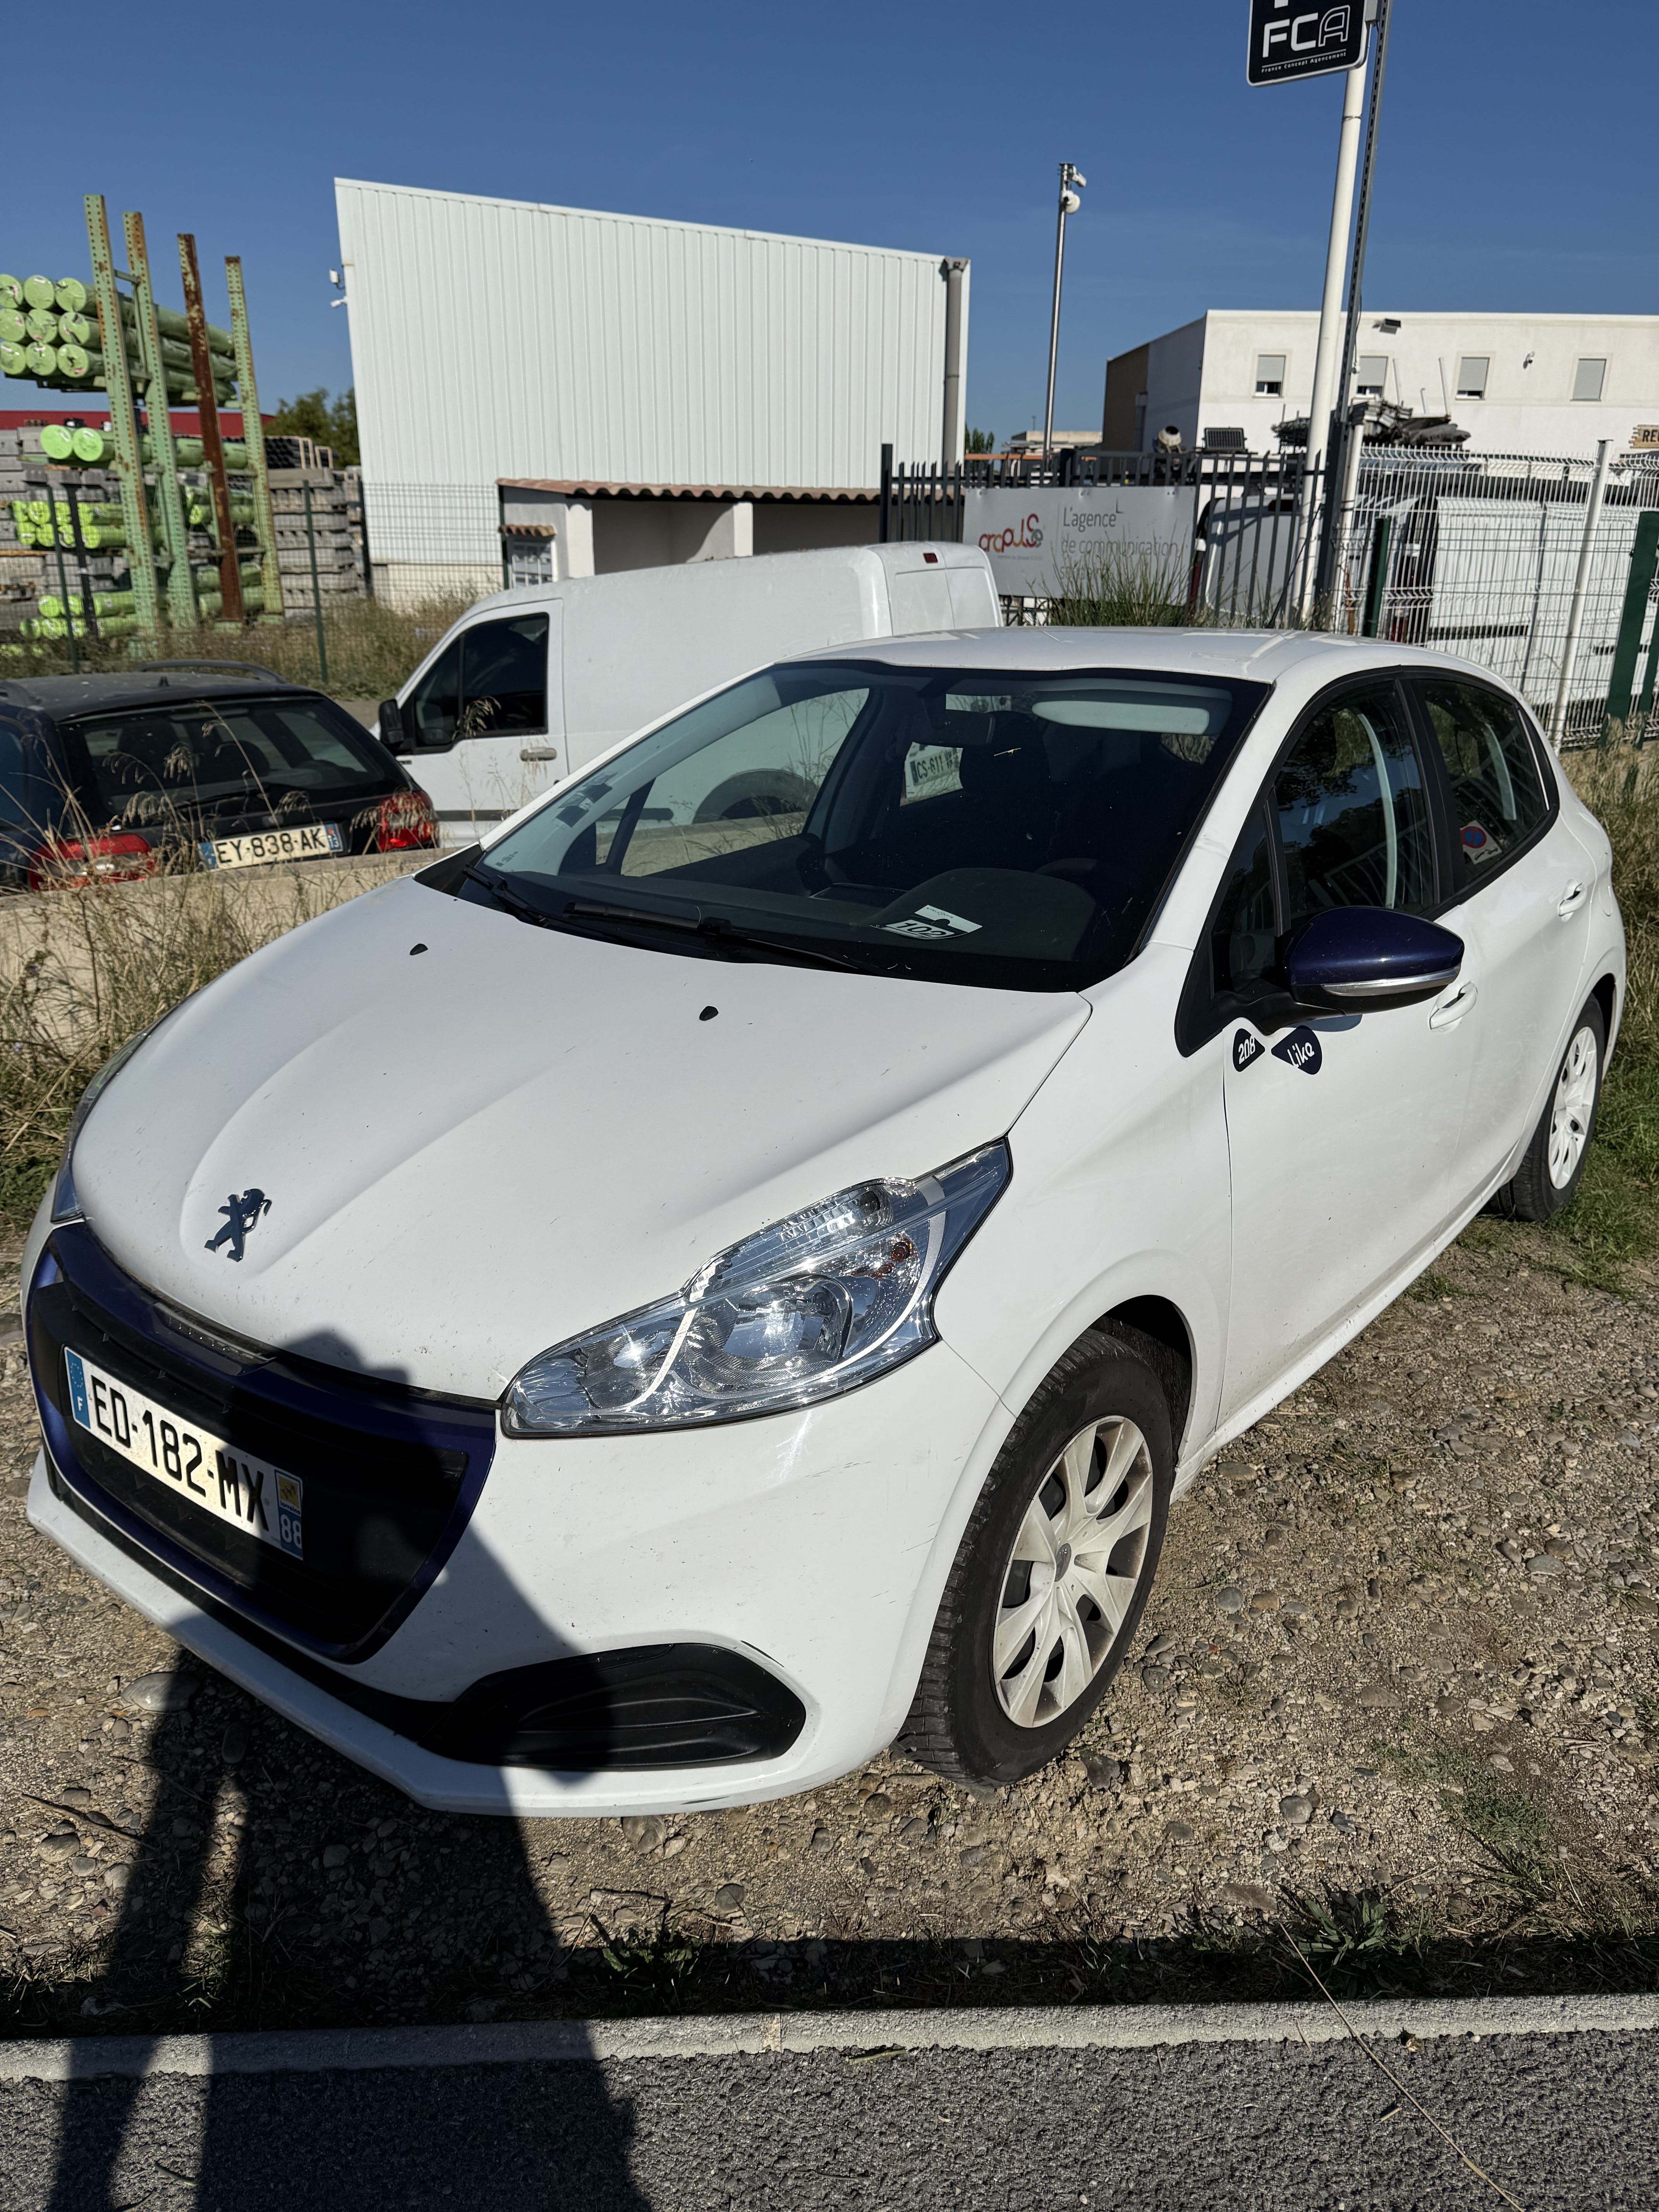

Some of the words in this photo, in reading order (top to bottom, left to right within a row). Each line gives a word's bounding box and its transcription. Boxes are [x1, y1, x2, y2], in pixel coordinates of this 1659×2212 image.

[1262, 5, 1350, 58] FCA
[1261, 65, 1281, 73] France
[1284, 60, 1307, 69] Concept
[1310, 52, 1346, 63] Agencement
[1642, 429, 1659, 442] RE
[1063, 507, 1116, 532] L'agence
[1061, 533, 1076, 553] de
[1079, 536, 1178, 556] communication
[215, 828, 327, 864] EY-838-AK
[328, 834, 339, 848] 13
[896, 922, 946, 938] 102
[1238, 1037, 1255, 1065] 208
[77, 1396, 83, 1411] F
[91, 1374, 269, 1532] ED-182-MX
[280, 1515, 302, 1549] 88
